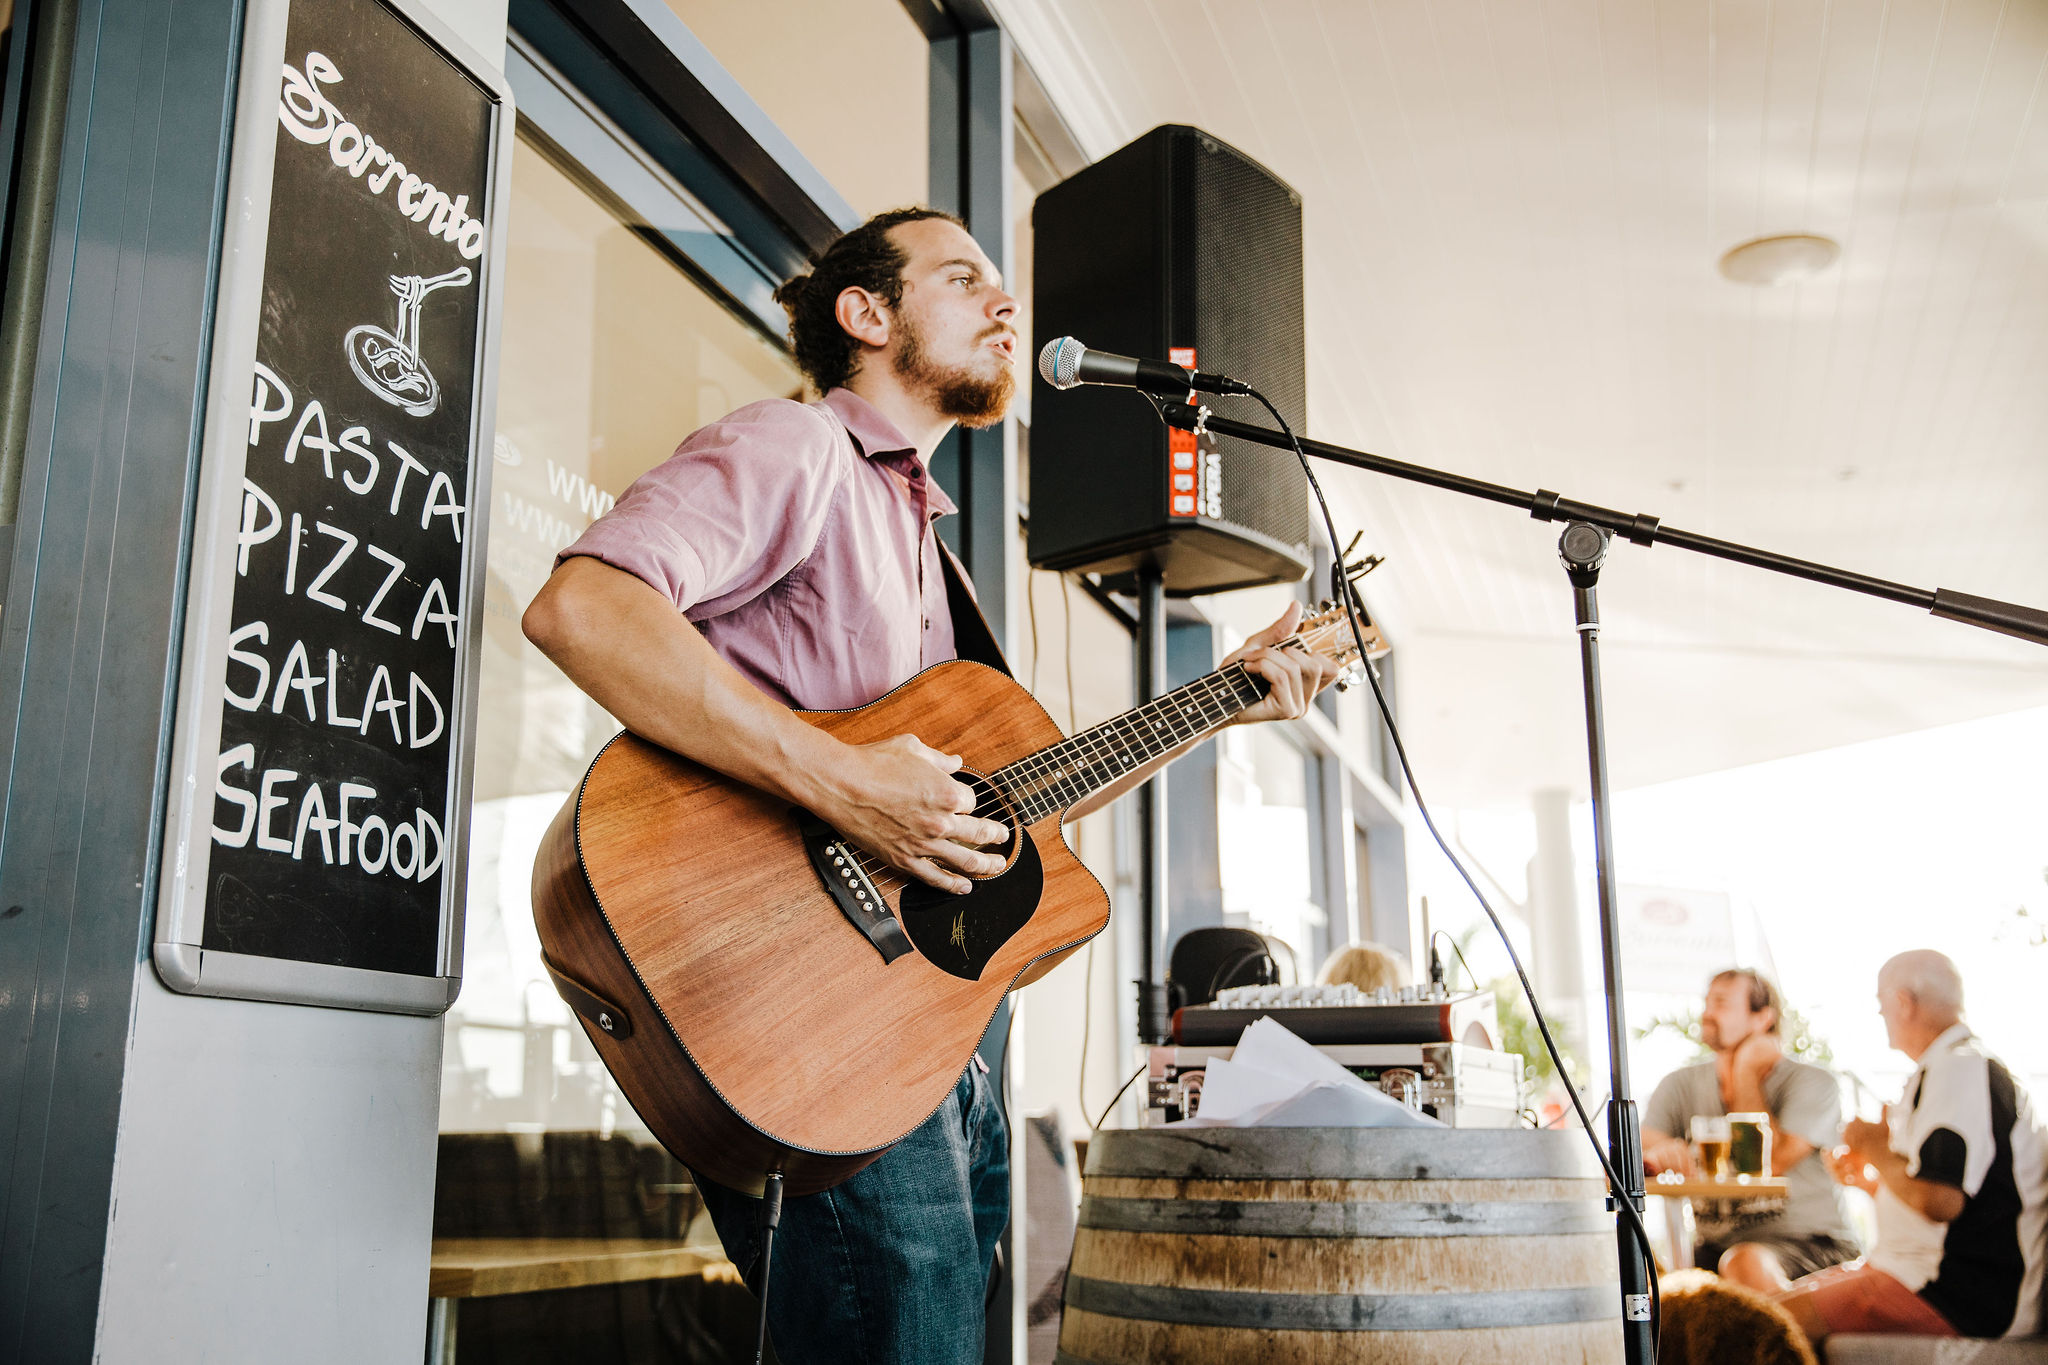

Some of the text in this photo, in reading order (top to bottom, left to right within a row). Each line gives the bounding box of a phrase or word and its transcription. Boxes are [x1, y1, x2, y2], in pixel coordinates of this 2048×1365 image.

[279, 52, 484, 260] Sorrento
[250, 361, 466, 543] PASTA
[238, 480, 459, 648] PIZZA
[224, 620, 444, 748] SALAD
[212, 743, 444, 882] SEAFOOD
